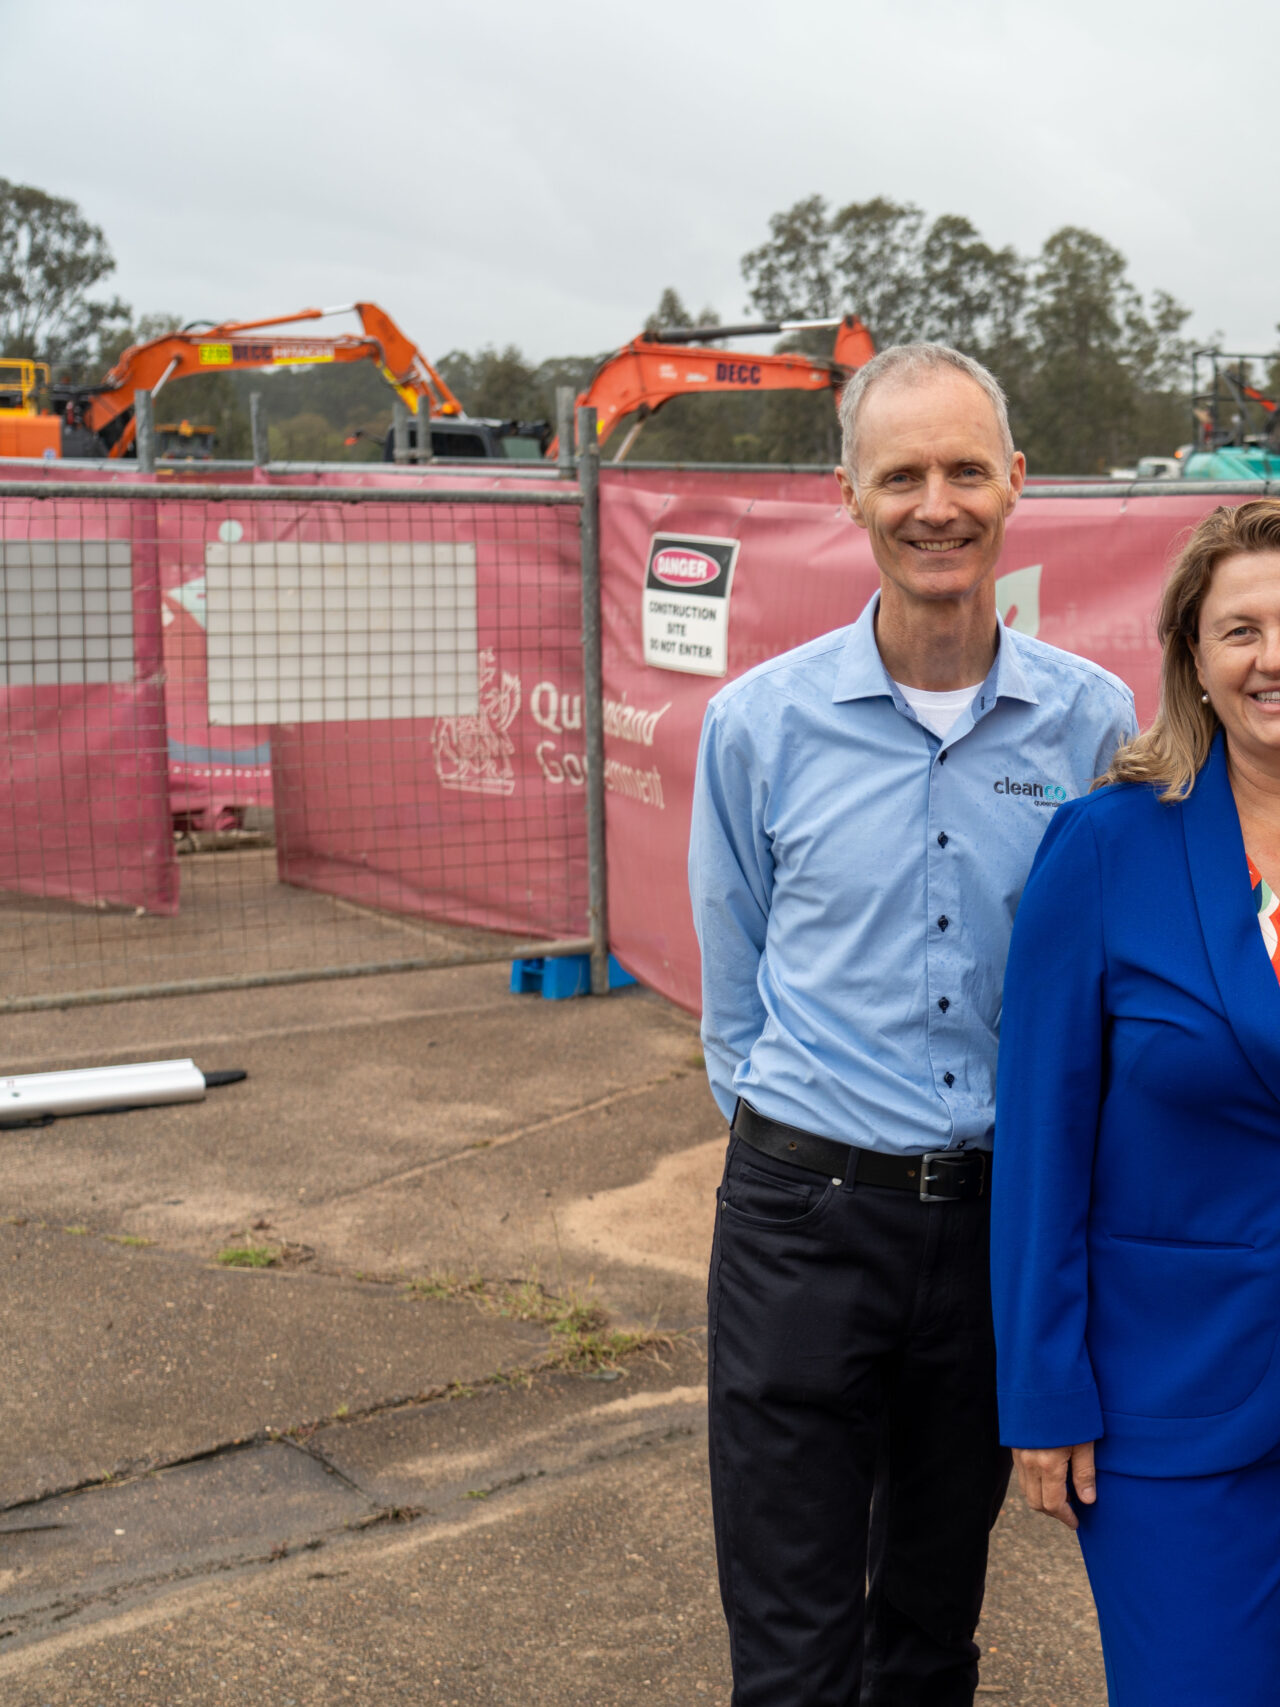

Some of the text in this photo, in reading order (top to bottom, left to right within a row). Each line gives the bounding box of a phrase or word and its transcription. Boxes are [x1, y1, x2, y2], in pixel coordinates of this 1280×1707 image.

[716, 363, 761, 384] DECC
[657, 556, 708, 579] DANGER
[649, 601, 717, 621] CONSTRUCTION
[667, 622, 687, 637] SITE
[650, 638, 659, 650] DO
[660, 640, 676, 653] NOT
[678, 641, 713, 659] ENTER
[993, 777, 1067, 801] cleanco
